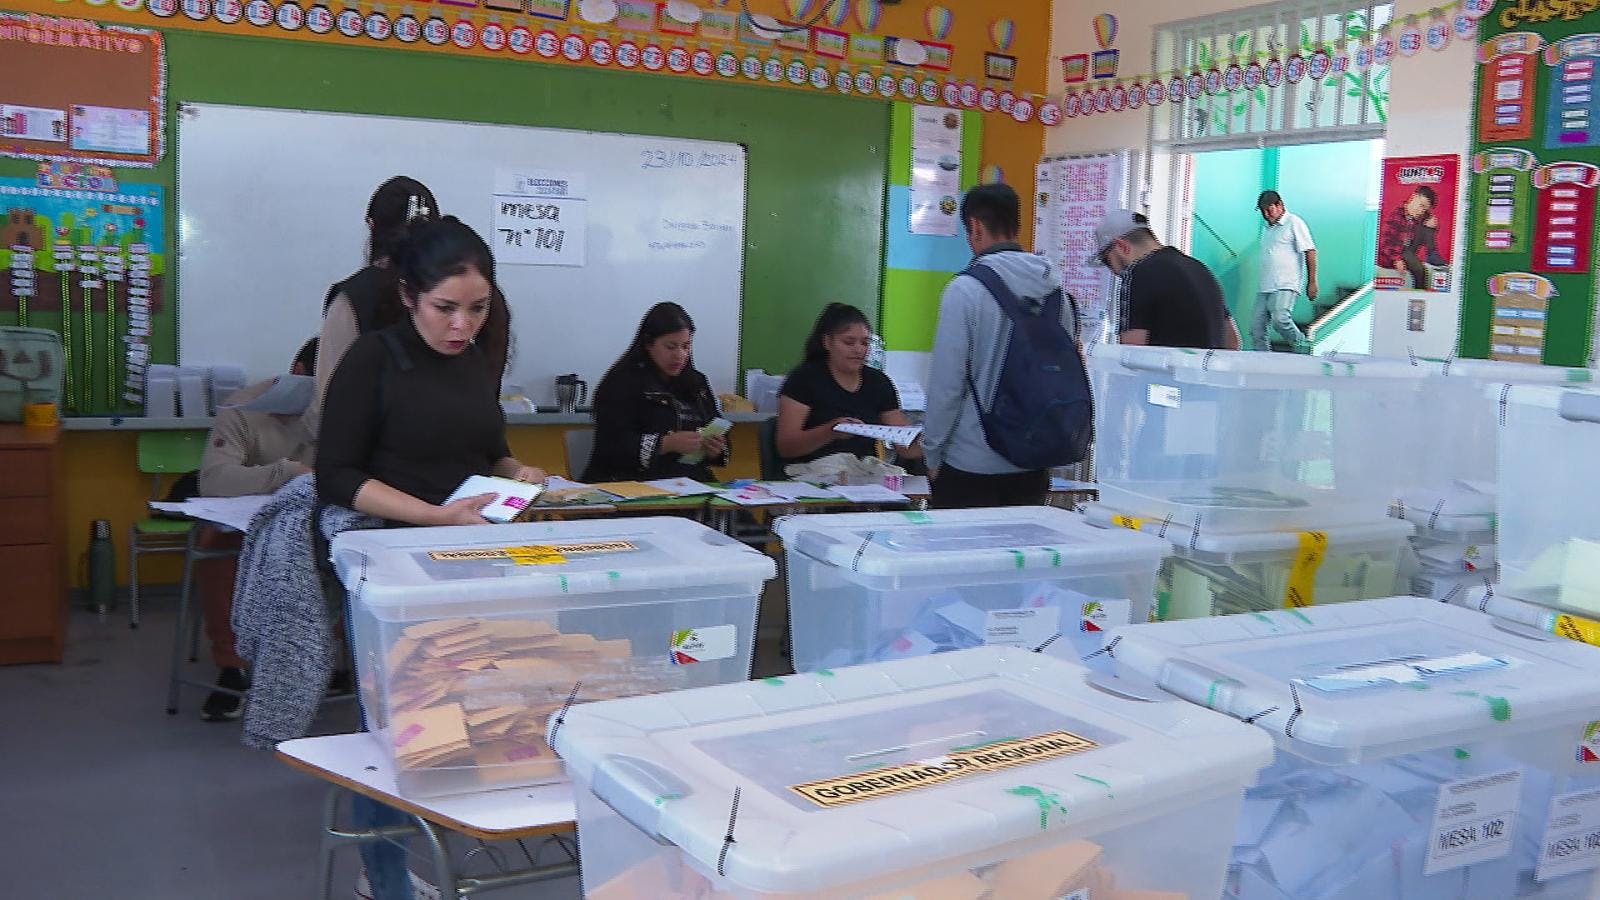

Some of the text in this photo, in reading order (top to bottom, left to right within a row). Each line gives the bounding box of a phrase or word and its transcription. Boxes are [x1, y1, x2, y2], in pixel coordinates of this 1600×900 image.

[184, 0, 206, 15] 11
[215, 2, 239, 17] 12
[250, 5, 272, 20] 13
[279, 8, 301, 23] 14
[309, 12, 331, 27] 15
[340, 16, 363, 30] 16
[366, 18, 387, 34] 17
[397, 20, 418, 37] 18
[427, 23, 446, 39] 19
[501, 202, 560, 223] mesa
[814, 737, 1081, 799] GOBERNADOR REGIONAL
[1439, 818, 1504, 850] MESA 102
[1547, 836, 1581, 859] MESA
